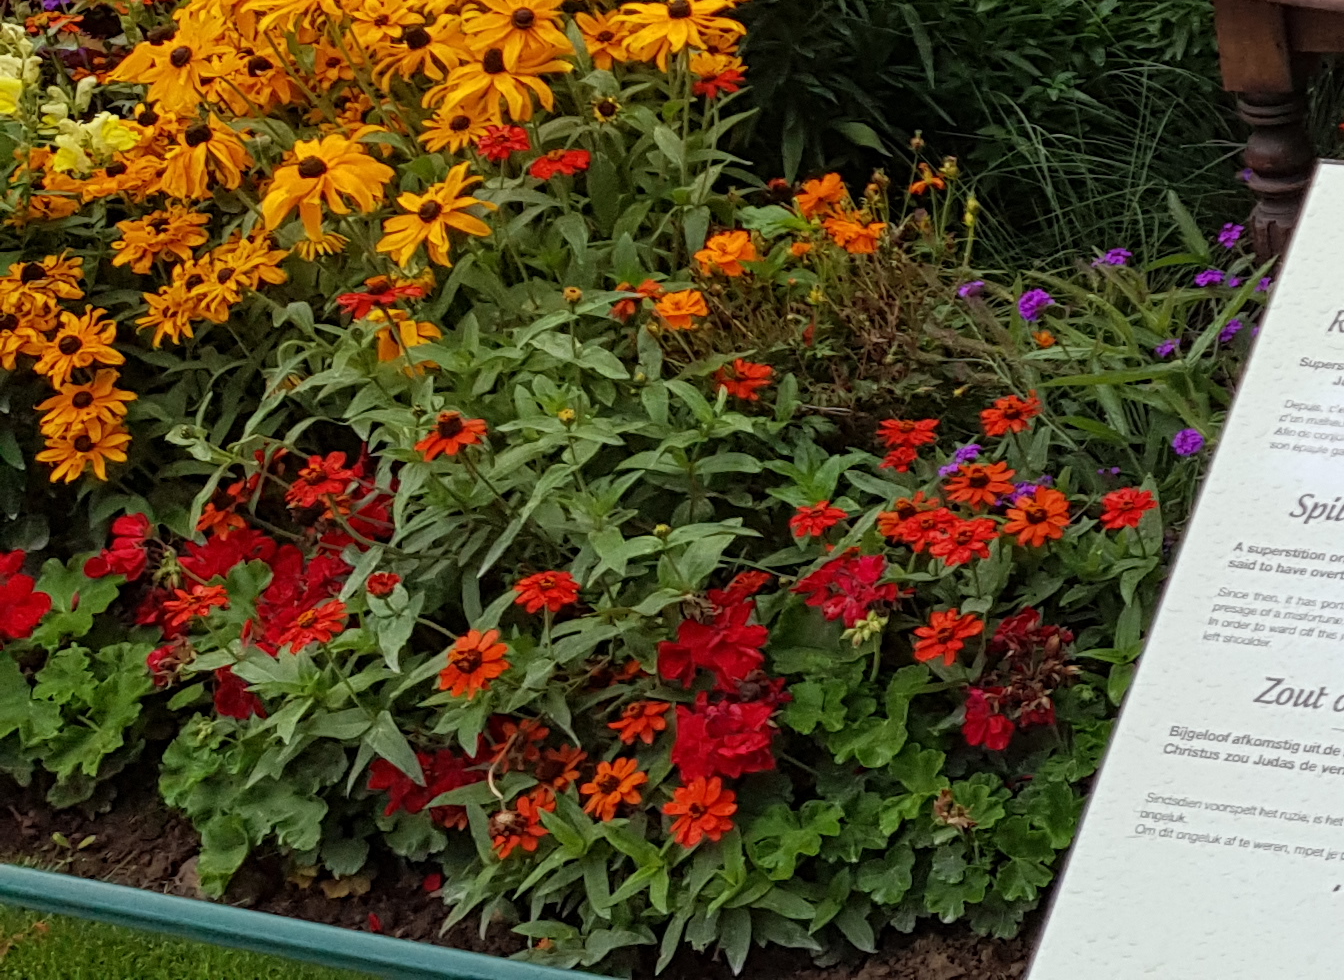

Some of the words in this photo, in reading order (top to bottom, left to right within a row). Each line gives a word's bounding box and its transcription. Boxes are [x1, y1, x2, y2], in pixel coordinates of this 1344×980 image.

[1231, 541, 1244, 552] A
[1246, 544, 1326, 561] superstition
[1226, 559, 1258, 571] said
[1257, 561, 1273, 572] to
[1274, 562, 1308, 576] have
[1252, 676, 1329, 709] Zout
[1167, 724, 1232, 743] Bijgeloof
[1230, 733, 1301, 754] afkomstig
[1302, 743, 1320, 756] uit
[1321, 745, 1342, 758] de
[1162, 742, 1220, 760] Christus
[1222, 752, 1250, 764] zou
[1251, 753, 1295, 770] Judas
[1298, 759, 1318, 772] de
